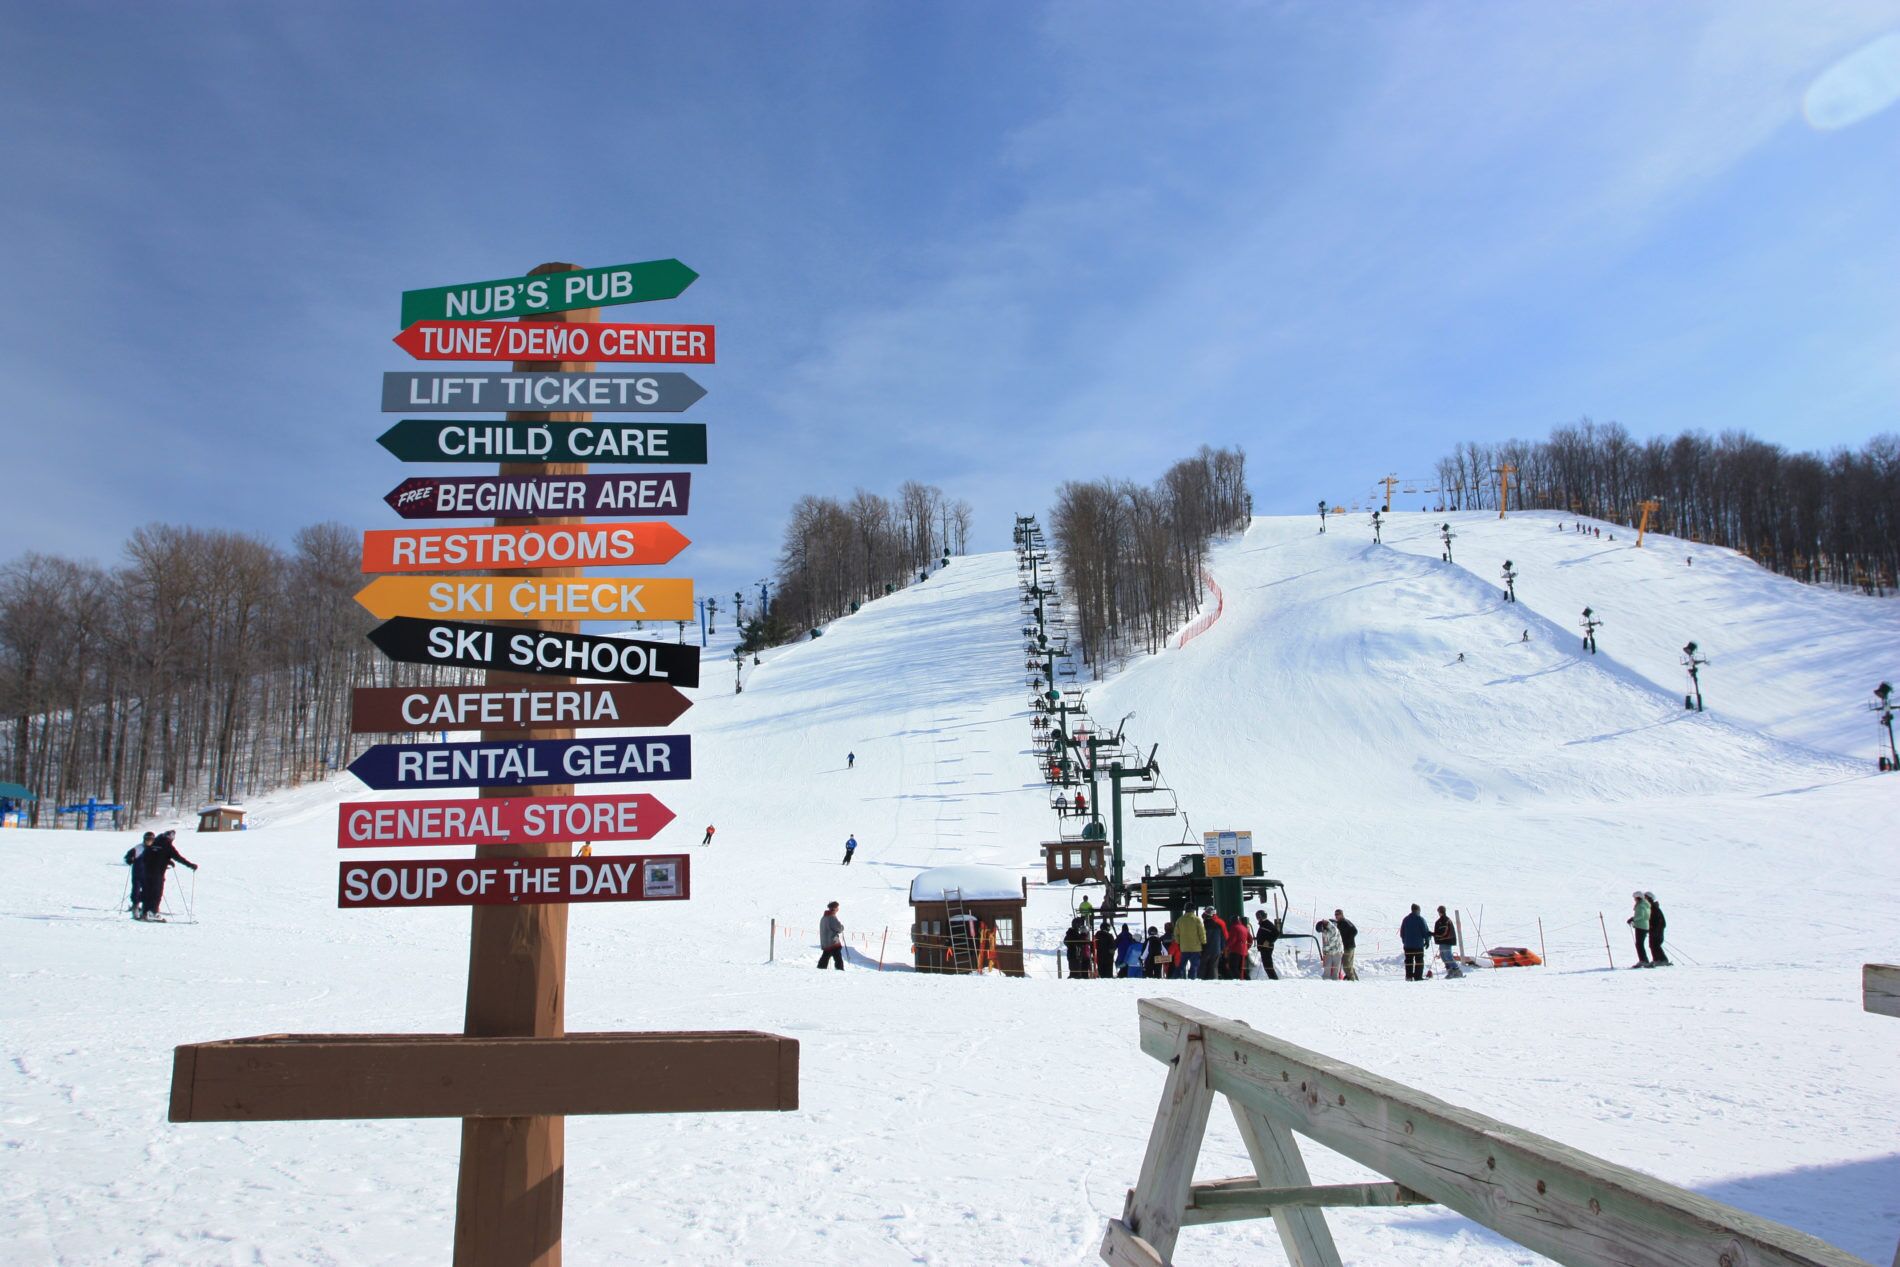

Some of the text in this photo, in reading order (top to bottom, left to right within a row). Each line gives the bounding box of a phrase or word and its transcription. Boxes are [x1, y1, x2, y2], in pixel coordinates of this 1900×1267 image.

[446, 271, 633, 318] NUB'S PUB
[419, 325, 706, 356] TUNE/DEMO CENTER
[409, 378, 659, 405] LIFT TICKETS
[438, 426, 669, 456] CHILD CARE
[398, 480, 678, 511] FREE BEGINNER AREA
[392, 530, 635, 565] RESTROOMS
[428, 582, 646, 613] SKI CHECK
[427, 627, 669, 677] SKI SCHOOL
[401, 691, 619, 724] CAFETERIA
[398, 743, 671, 782] RENTAL GEAR
[349, 802, 638, 840] GENERAL STORE
[344, 863, 636, 901] SOUP OF THE DAY
